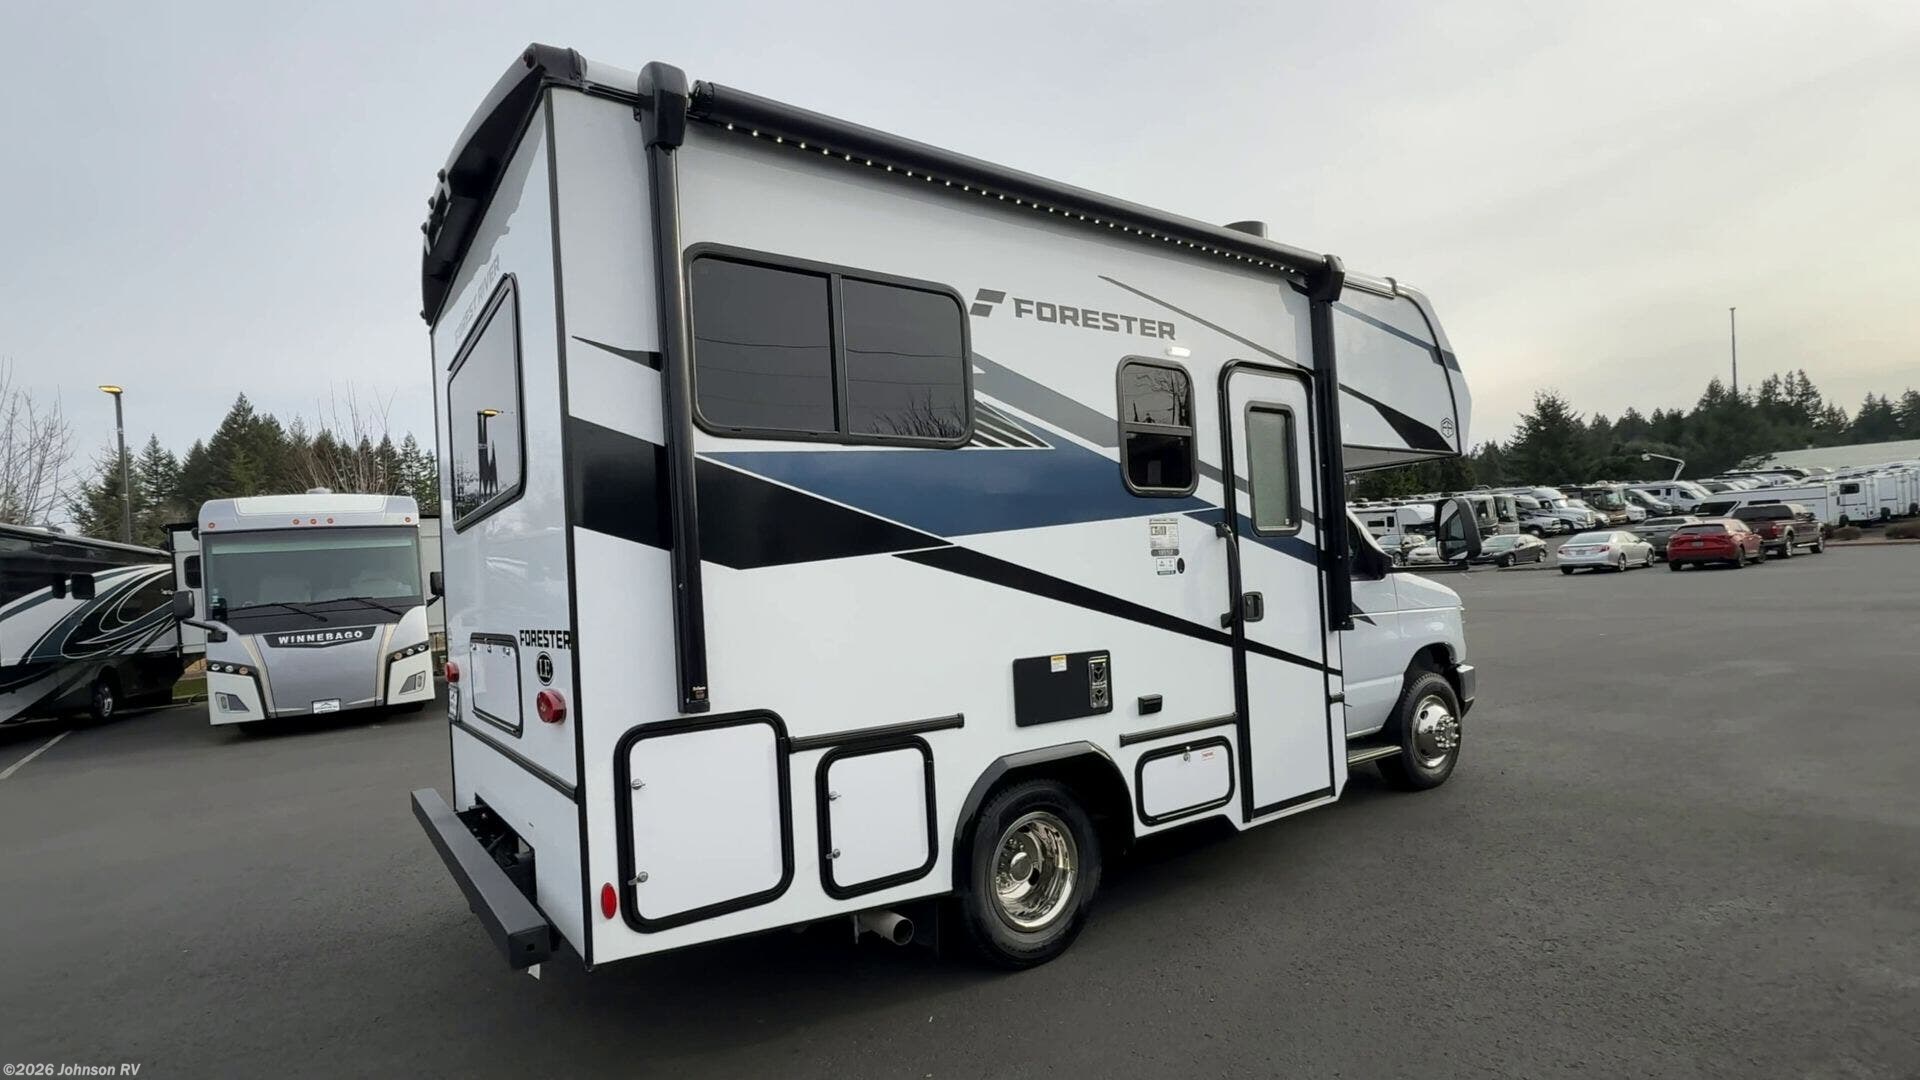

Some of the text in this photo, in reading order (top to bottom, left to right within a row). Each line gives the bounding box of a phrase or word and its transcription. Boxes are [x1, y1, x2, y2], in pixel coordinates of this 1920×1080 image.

[1012, 297, 1176, 341] FORESTER
[278, 630, 364, 645] WINNEBAGO
[519, 629, 571, 650] FORESTER
